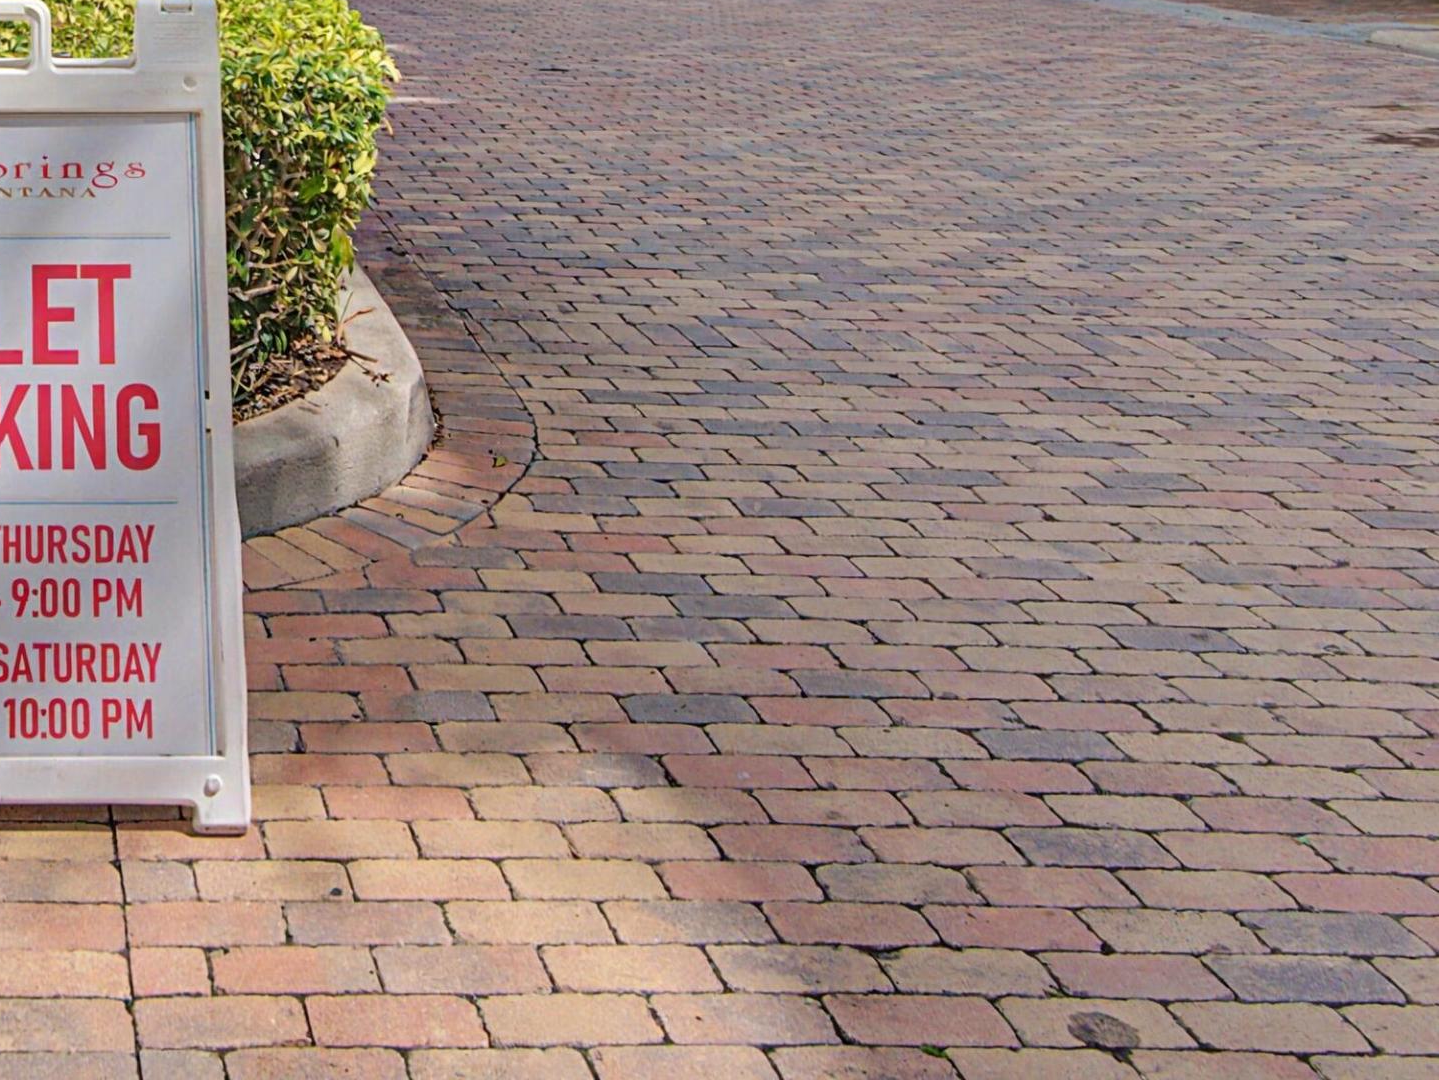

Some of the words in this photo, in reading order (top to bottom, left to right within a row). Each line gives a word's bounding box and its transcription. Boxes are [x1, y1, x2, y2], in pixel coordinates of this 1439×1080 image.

[11, 578, 81, 618] 9:00
[92, 577, 143, 617] PM
[3, 698, 92, 740] 10:00
[102, 698, 154, 740] PM
